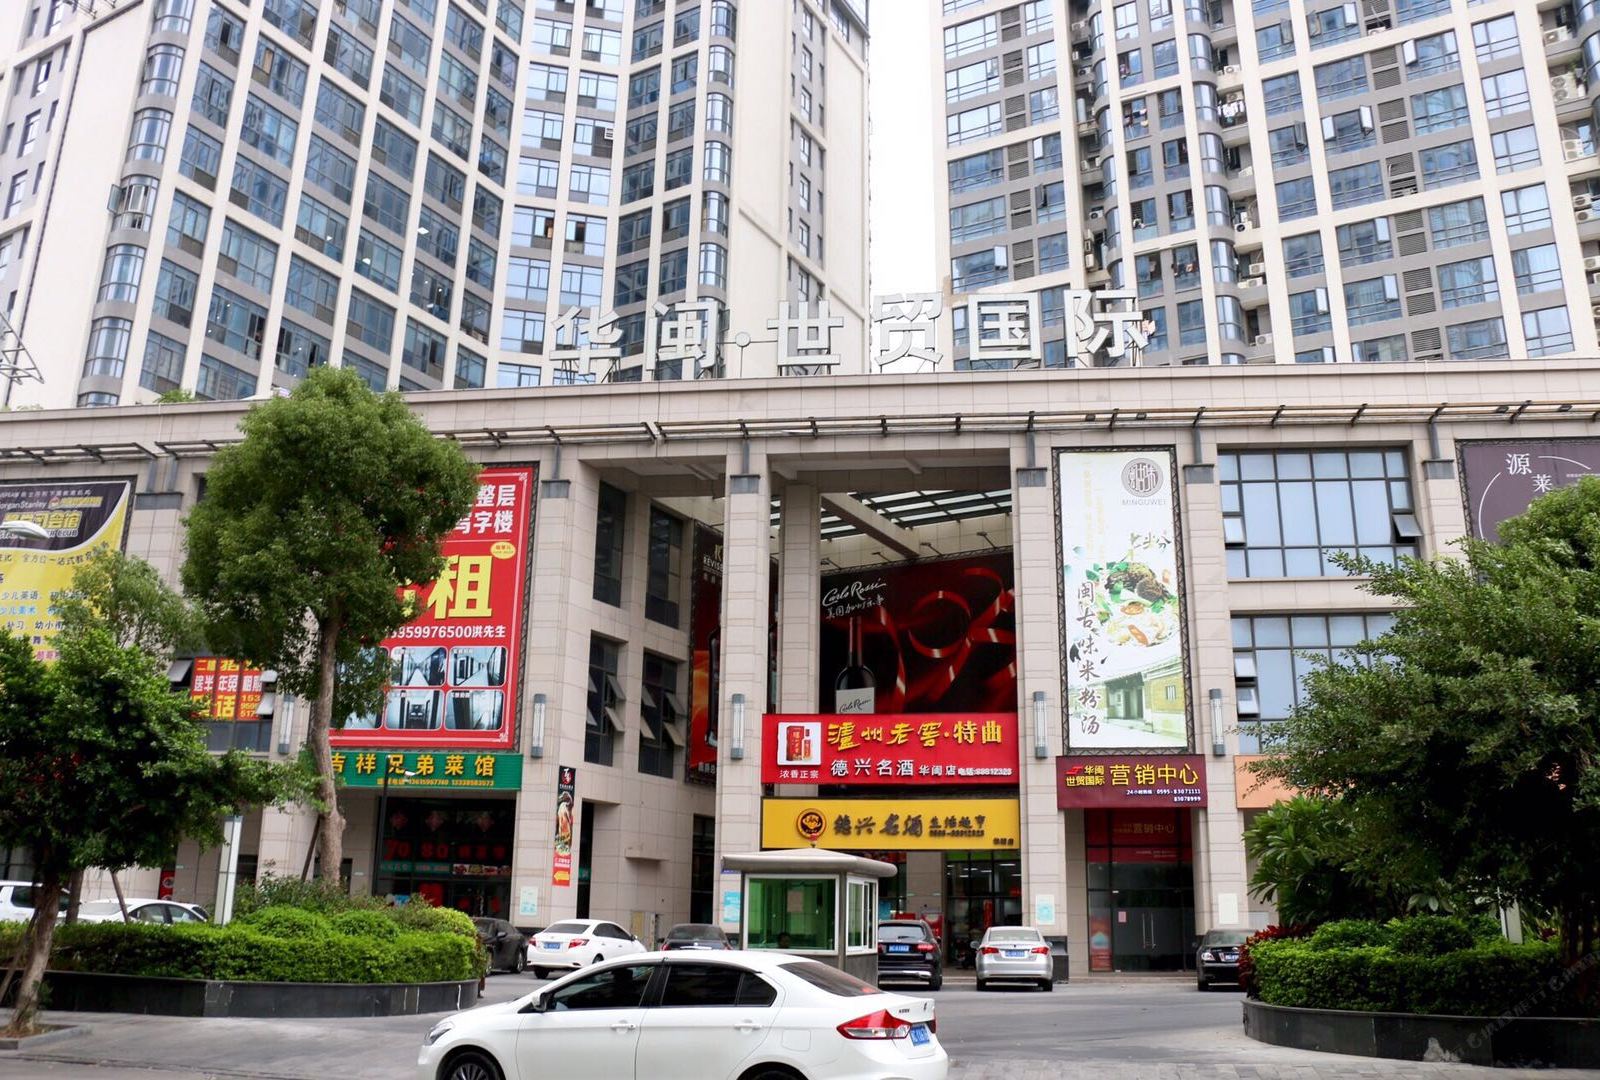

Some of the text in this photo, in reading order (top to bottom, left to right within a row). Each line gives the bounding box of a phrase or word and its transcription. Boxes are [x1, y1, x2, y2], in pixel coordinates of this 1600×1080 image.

[822, 588, 850, 607] Carlo
[850, 577, 886, 600] Rossi
[831, 758, 914, 776] 德兴名酒
[1110, 763, 1199, 785] 营销中心
